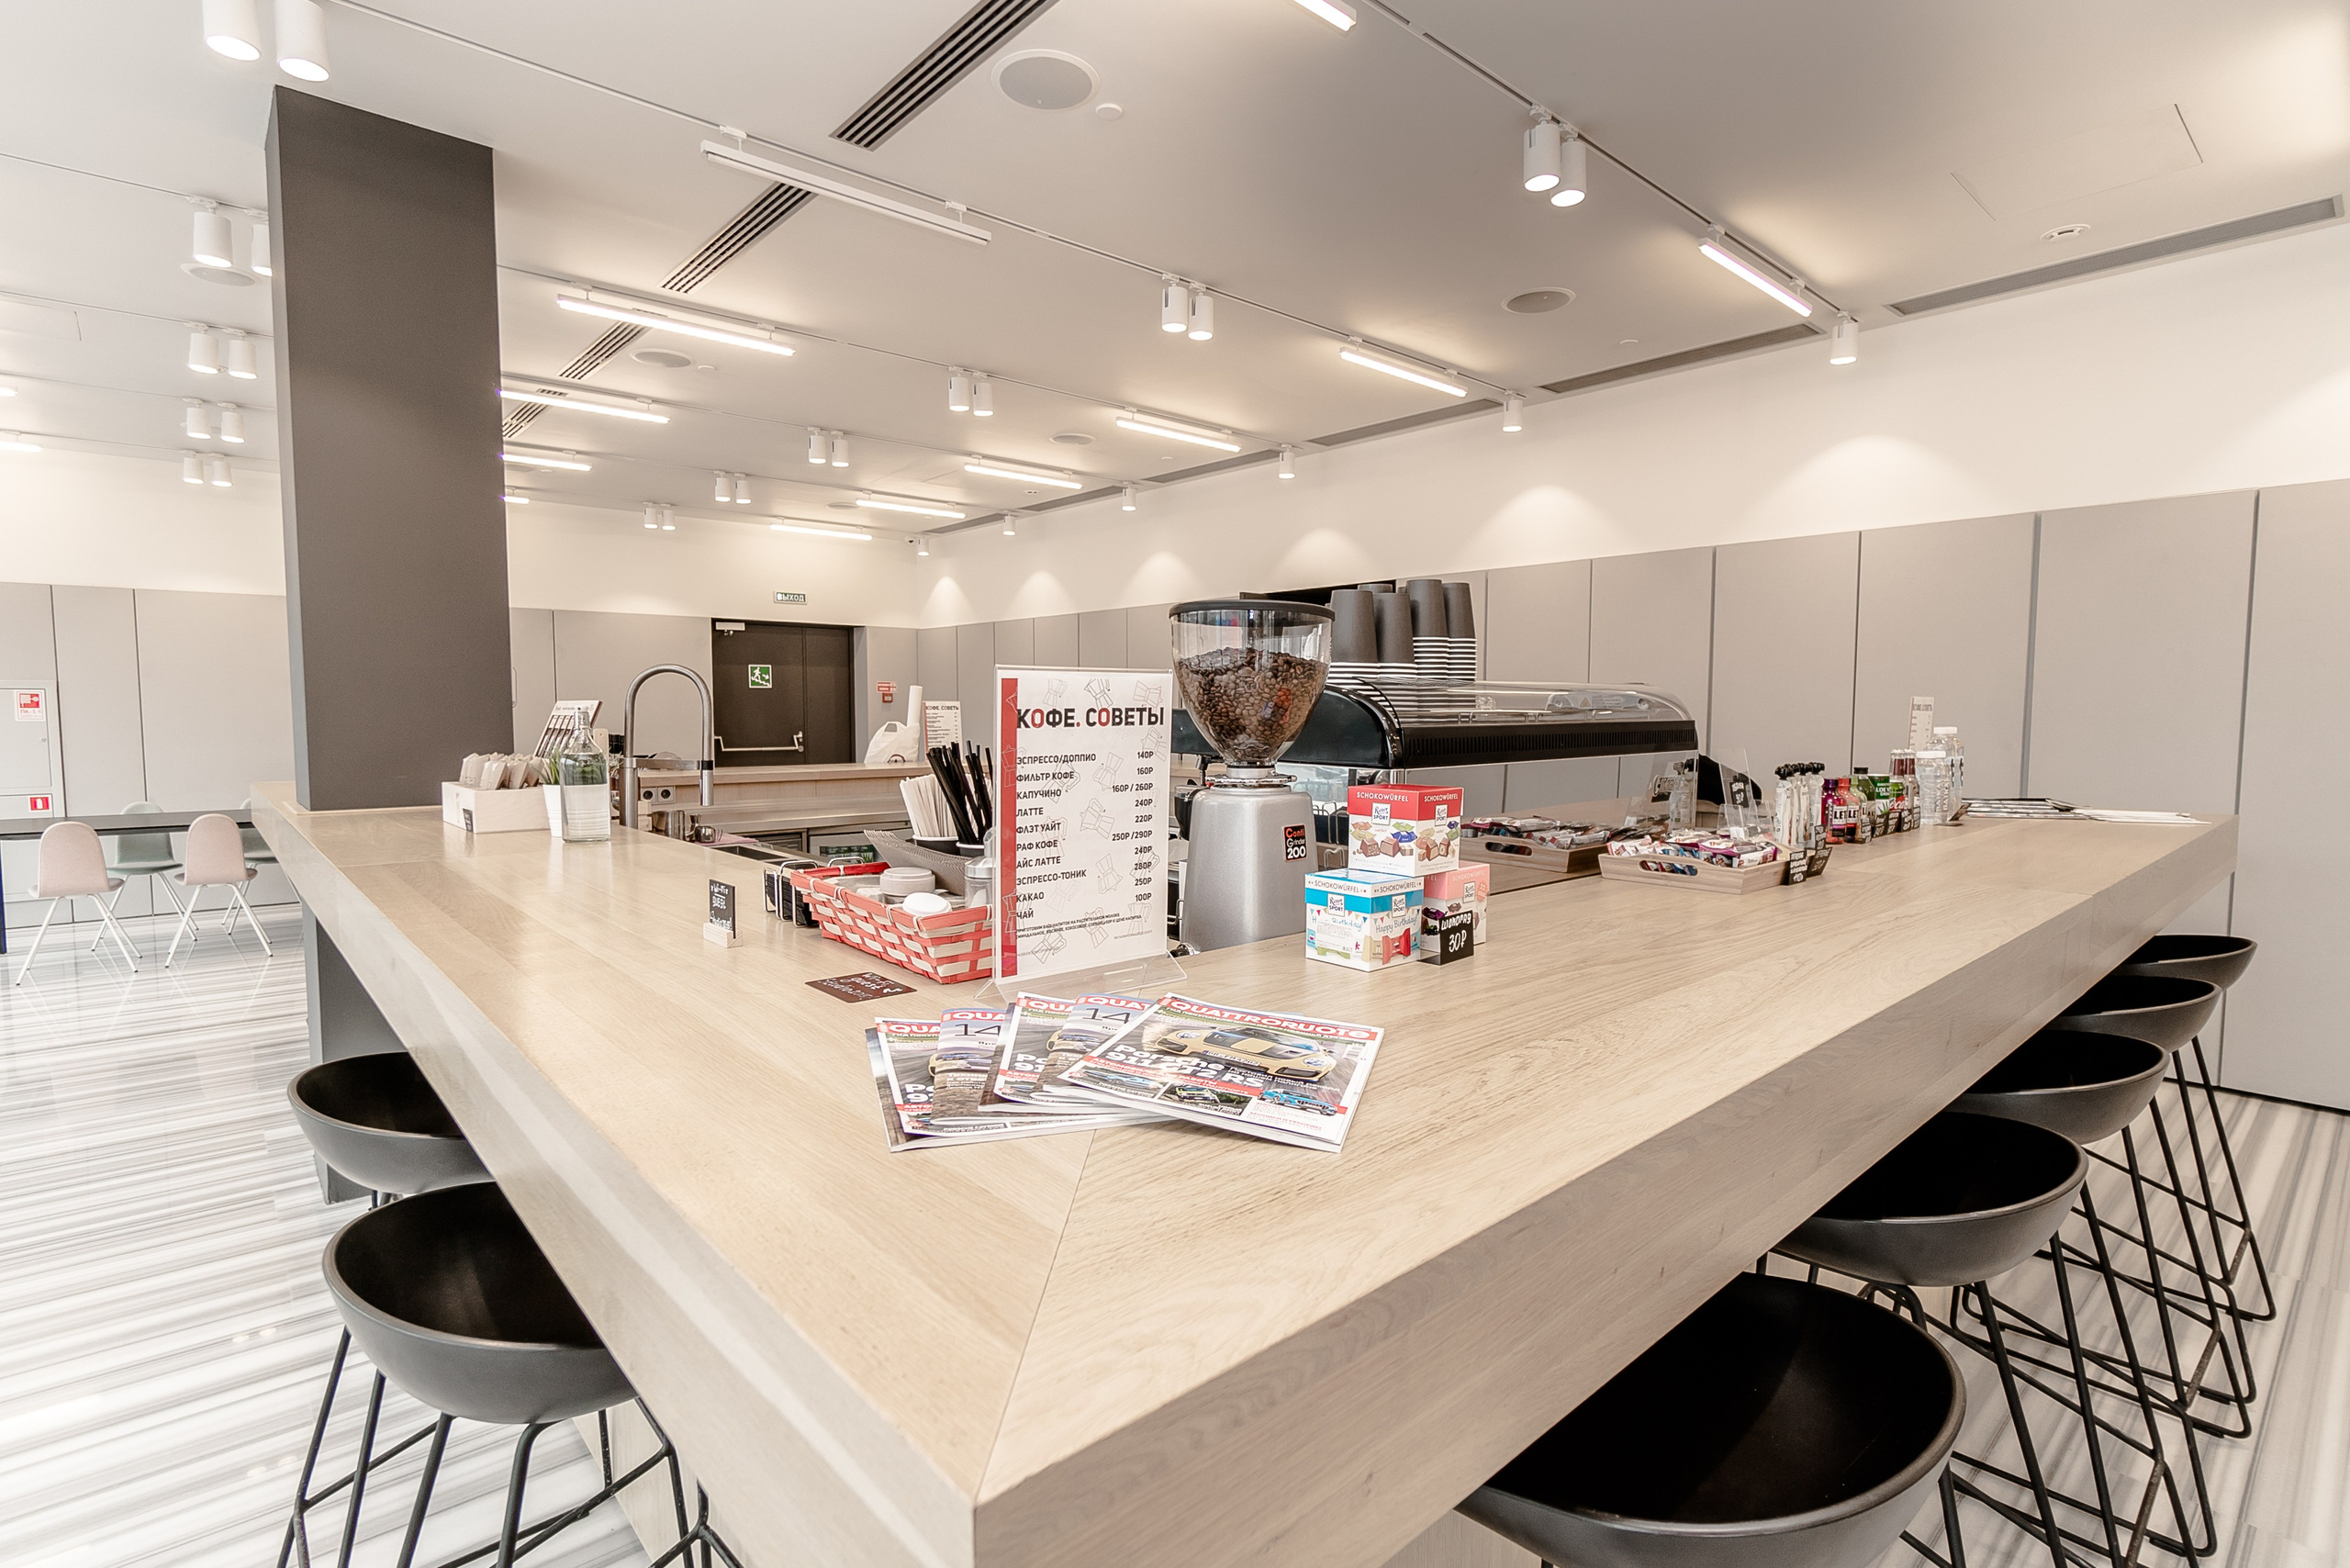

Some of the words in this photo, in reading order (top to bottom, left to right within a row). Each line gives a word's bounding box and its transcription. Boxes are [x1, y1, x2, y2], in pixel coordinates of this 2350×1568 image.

[777, 593, 804, 601] ВЫХОД
[1017, 708, 1080, 729] КОФЕ.
[1086, 707, 1164, 726] СОВЕТЫ
[1017, 753, 1096, 765] ЭСПРЕССО/ДОППИО
[1017, 772, 1050, 782] ФИЛЬТР
[1052, 771, 1074, 780] КОФЕ
[1113, 784, 1129, 792] 160Р
[1135, 782, 1154, 791] 260Р
[1017, 789, 1061, 800] КАПУЧИНО
[1357, 791, 1408, 802] SCHOKOWÜRFEL
[1425, 793, 1458, 802] SCHOKOWÜRFEL
[1135, 799, 1153, 807] 240Р
[1016, 807, 1044, 817] ЛАТТЕ
[1135, 814, 1153, 823] 220Р
[1016, 824, 1039, 834] ФЛЭТ
[1041, 821, 1061, 832] УАЙТ
[1112, 832, 1130, 841] 250Р
[1016, 842, 1034, 852] РАФ
[1035, 840, 1058, 849] КОФЕ
[1135, 846, 1153, 855] 240Р
[1287, 846, 1305, 859] 200
[1016, 857, 1034, 868] АЙС
[1034, 856, 1061, 867] ЛАТТЕ
[1134, 861, 1152, 870] 280Р
[1016, 869, 1087, 886] ЭСПРЕССО-ТОНИК
[1452, 870, 1485, 881] SCHOKOWÜRFEL
[1135, 878, 1152, 887] 250Р
[1315, 880, 1359, 893] SCHOKOWÜRFEL
[1380, 881, 1416, 892] SCHOKOWÜRFEL
[1016, 891, 1045, 903] КАКАО
[1135, 893, 1152, 902] 100Р
[1017, 908, 1034, 920] ЧАЙ
[1375, 924, 1393, 935] Happy
[1393, 916, 1417, 929] Birthday!
[1082, 1008, 1131, 1025] 14
[1171, 998, 1371, 1039] QUATTRORUOTE
[955, 1024, 1001, 1036] 14
[1113, 1045, 1226, 1070] Porsche
[1105, 1052, 1153, 1069] 911
[1158, 1061, 1215, 1079] GT2
[1222, 1073, 1265, 1088] RS
